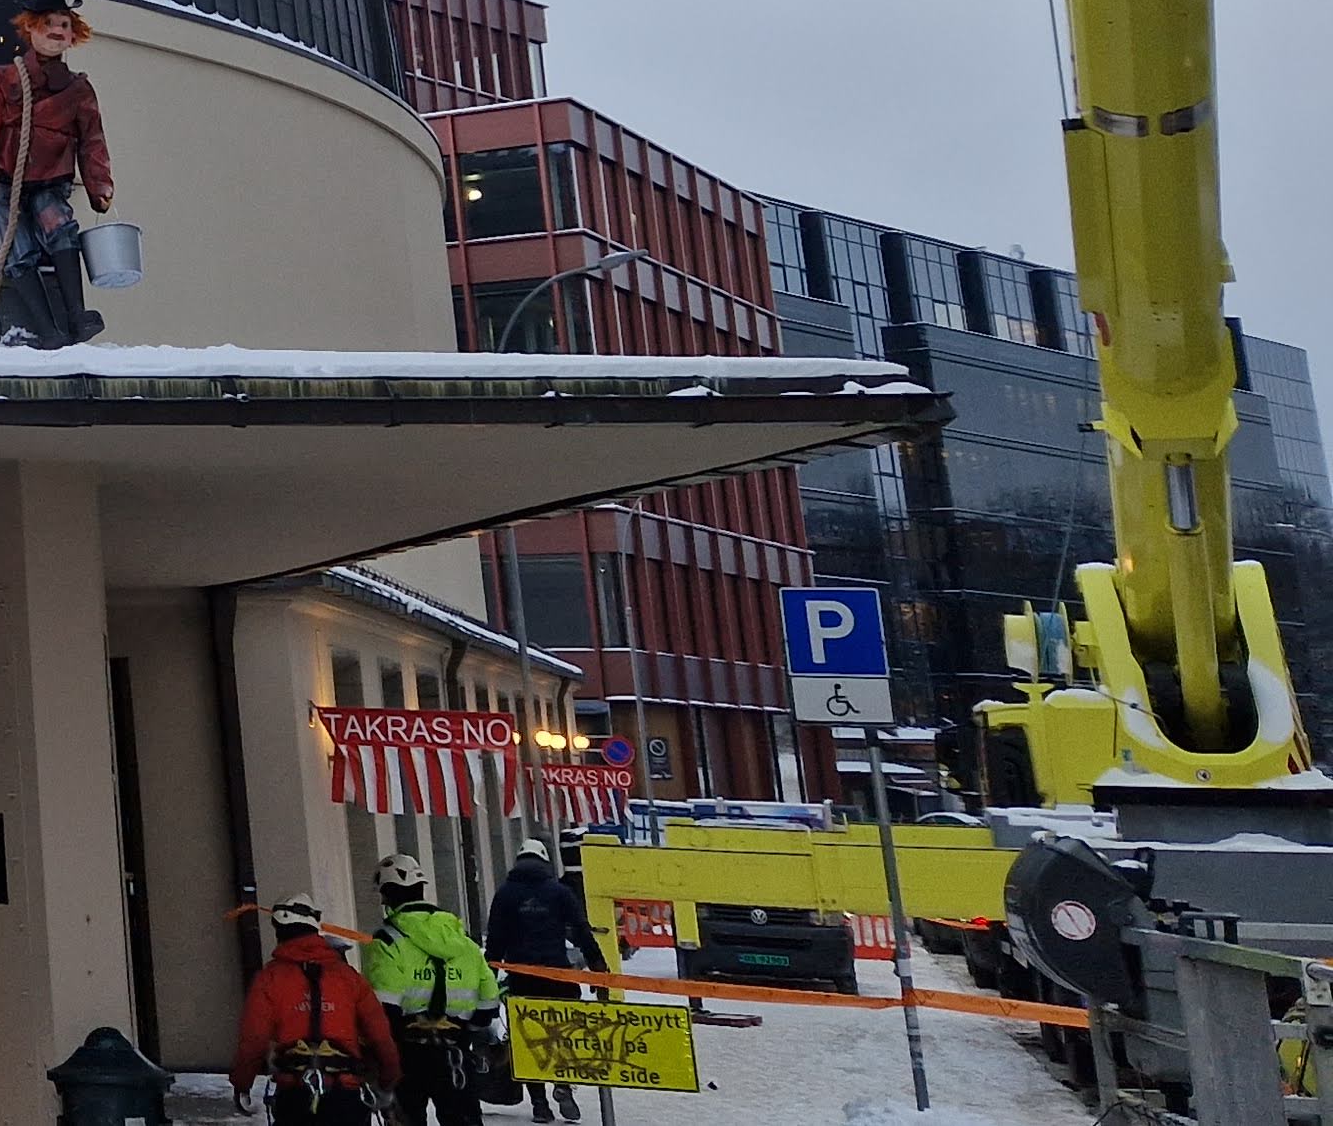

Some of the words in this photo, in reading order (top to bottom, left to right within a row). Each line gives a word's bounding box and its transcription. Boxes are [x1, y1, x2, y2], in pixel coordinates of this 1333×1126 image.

[805, 600, 855, 664] P
[323, 713, 512, 747] TAKRAS.NO
[526, 766, 632, 787] TAKRAS.NO
[616, 1009, 681, 1032] benytt
[625, 1037, 648, 1054] på
[620, 1066, 660, 1084] side
